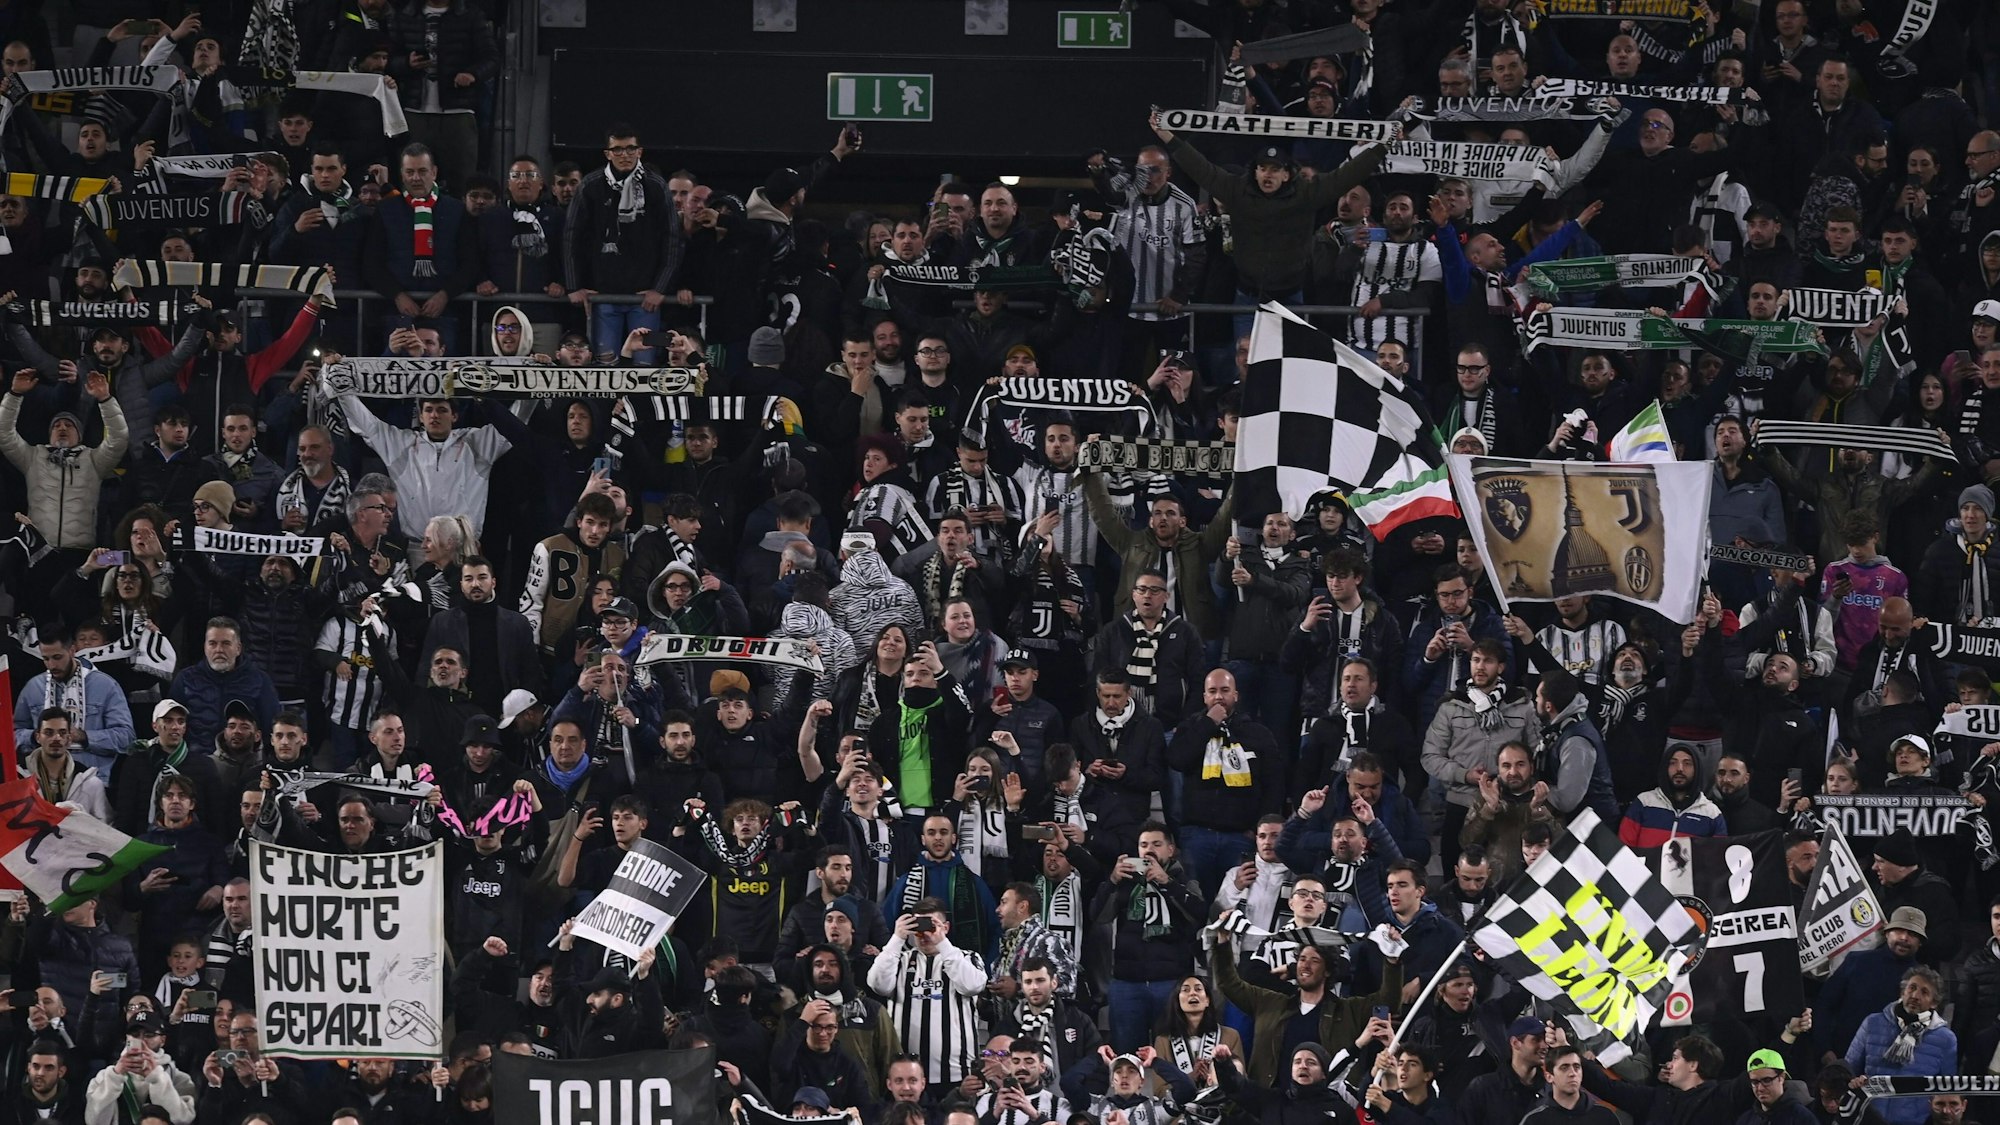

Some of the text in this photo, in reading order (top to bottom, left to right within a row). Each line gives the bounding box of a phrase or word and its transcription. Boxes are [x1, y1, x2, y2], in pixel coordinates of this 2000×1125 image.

[52, 66, 156, 89] JUVENTUS
[1434, 96, 1574, 113] JUVENTUS
[1168, 110, 1271, 134] ODIATI
[1307, 121, 1385, 141] FIERI
[117, 197, 210, 221] JUVENTUS
[1632, 259, 1694, 276] JUVENTUS
[59, 302, 150, 318] JUVENTUS
[1561, 317, 1626, 337] JUVENTUS
[509, 370, 638, 391] JUVENTUS
[997, 378, 1131, 406] JUVENTUS
[1078, 449, 1138, 476] FORZA
[204, 532, 313, 555] JUVENTUS
[551, 550, 581, 600] B
[860, 595, 904, 614] JUVE
[1842, 591, 1883, 610] Jeep
[667, 637, 780, 657] DRUGHI
[1856, 796, 1900, 806] GRANDE
[1823, 806, 1969, 837] JUVENTUS
[1725, 844, 1754, 904] 8
[463, 878, 502, 897] Jeep
[728, 878, 769, 895] Jeep
[260, 893, 400, 941] MORTE
[1811, 914, 1845, 943] CLUB
[263, 947, 326, 993] NON
[335, 951, 372, 994] CI
[1733, 951, 1766, 1013] 7
[912, 978, 941, 991] Jeep
[266, 1001, 383, 1047] SEPARI
